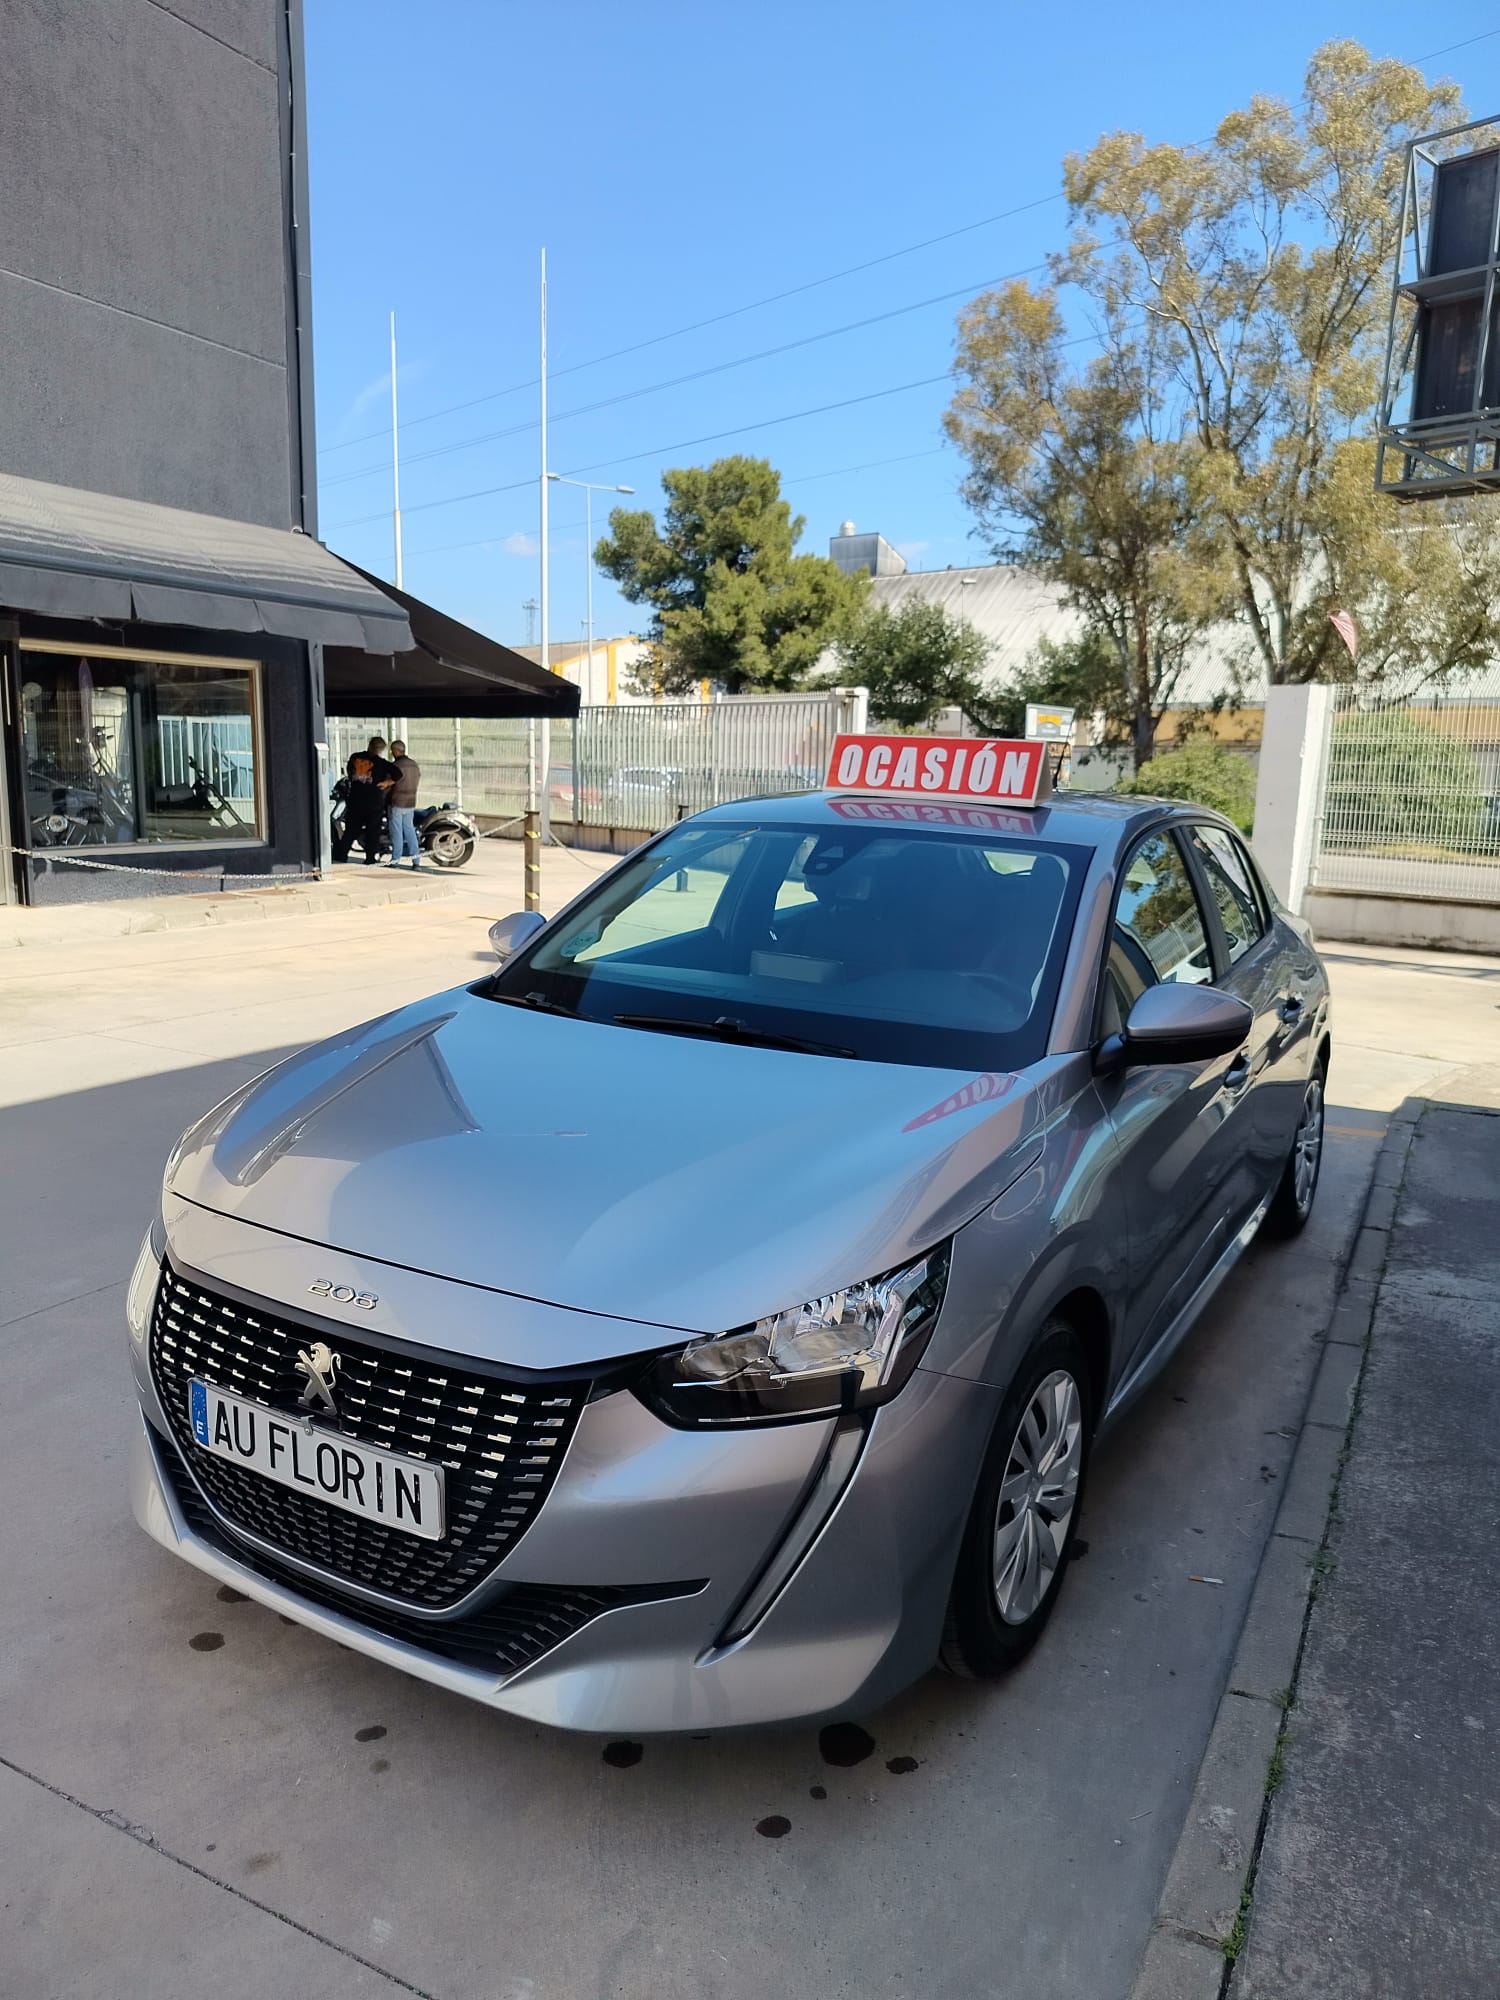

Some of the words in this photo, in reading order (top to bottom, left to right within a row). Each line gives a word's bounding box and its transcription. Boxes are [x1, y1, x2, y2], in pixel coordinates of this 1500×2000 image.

[837, 741, 1030, 796] OCASIÓN
[307, 1278, 379, 1310] 208
[196, 1420, 204, 1436] E
[214, 1399, 256, 1457] AU
[268, 1421, 422, 1525] FLORIN
